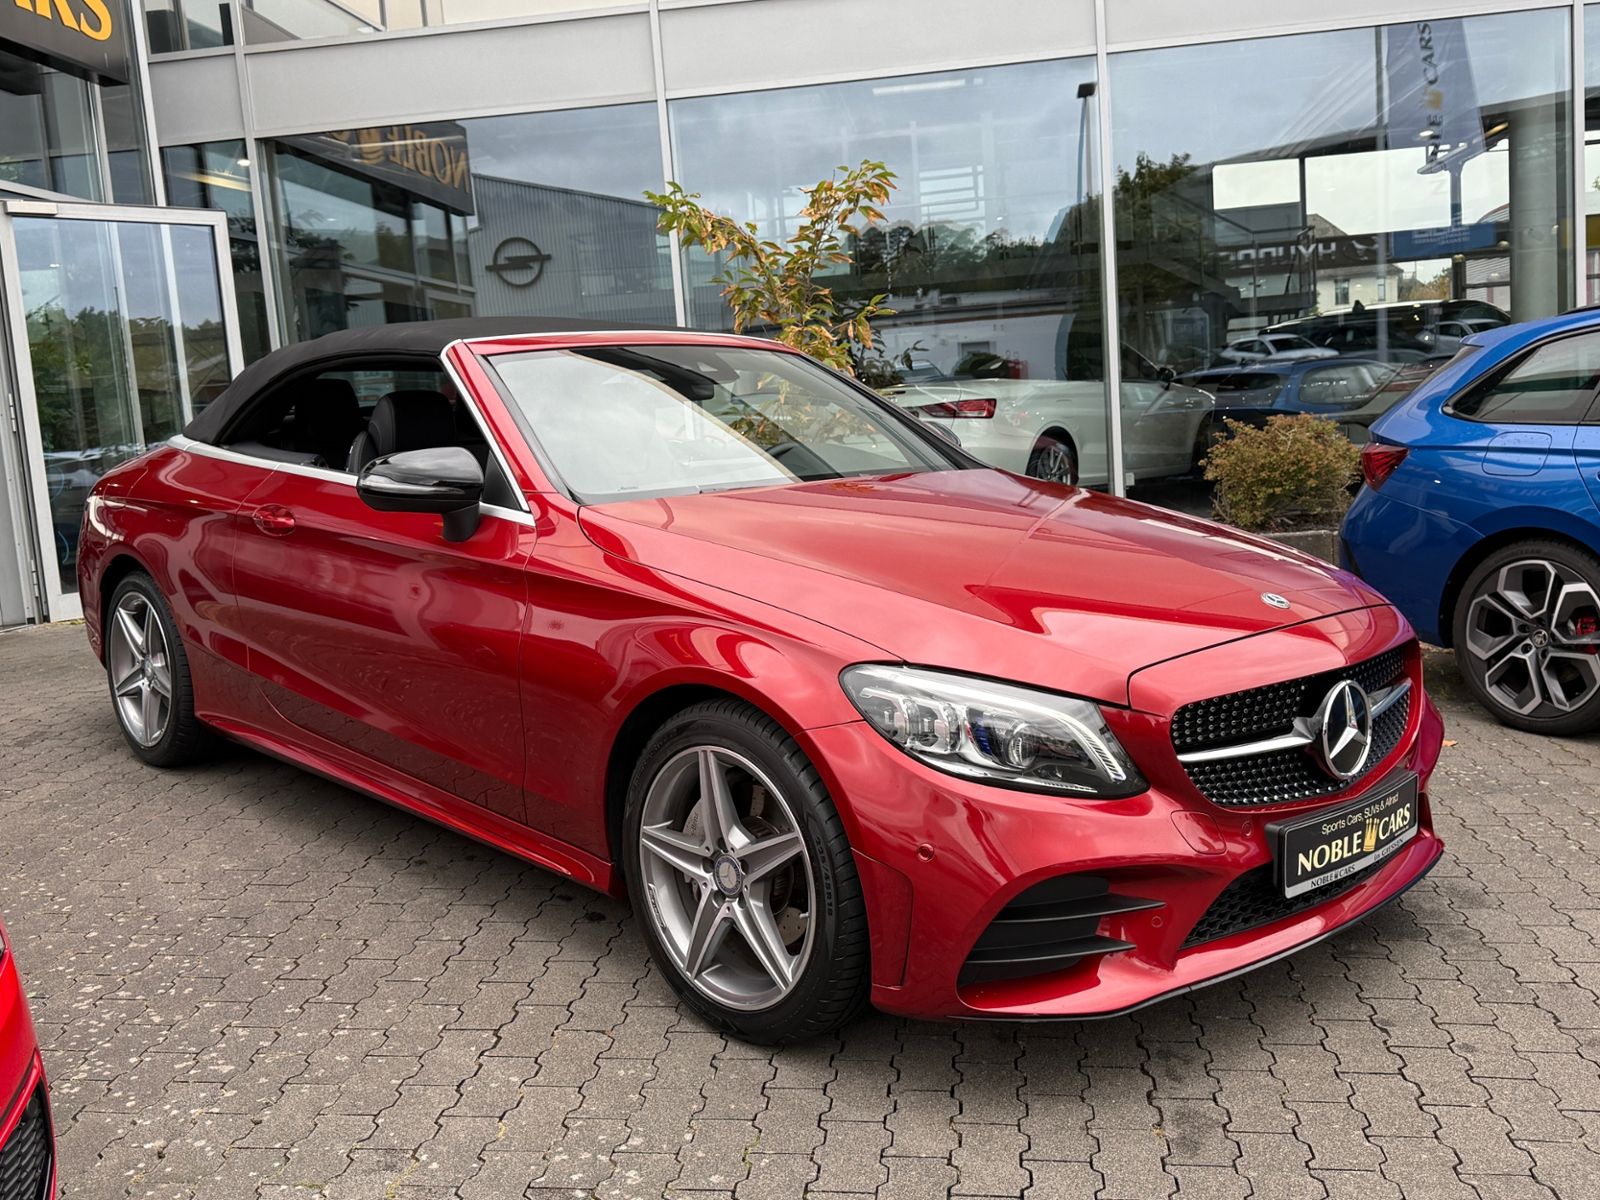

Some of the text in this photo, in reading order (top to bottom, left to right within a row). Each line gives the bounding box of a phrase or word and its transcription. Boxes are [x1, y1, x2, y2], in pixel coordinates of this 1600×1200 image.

[1417, 22, 1438, 86] CARS
[1297, 802, 1411, 877] NOBLE CARS
[1321, 819, 1346, 836] Sports
[1364, 805, 1380, 819] SUVs
[1309, 872, 1334, 889] NOBLE
[1338, 863, 1357, 878] CARS
